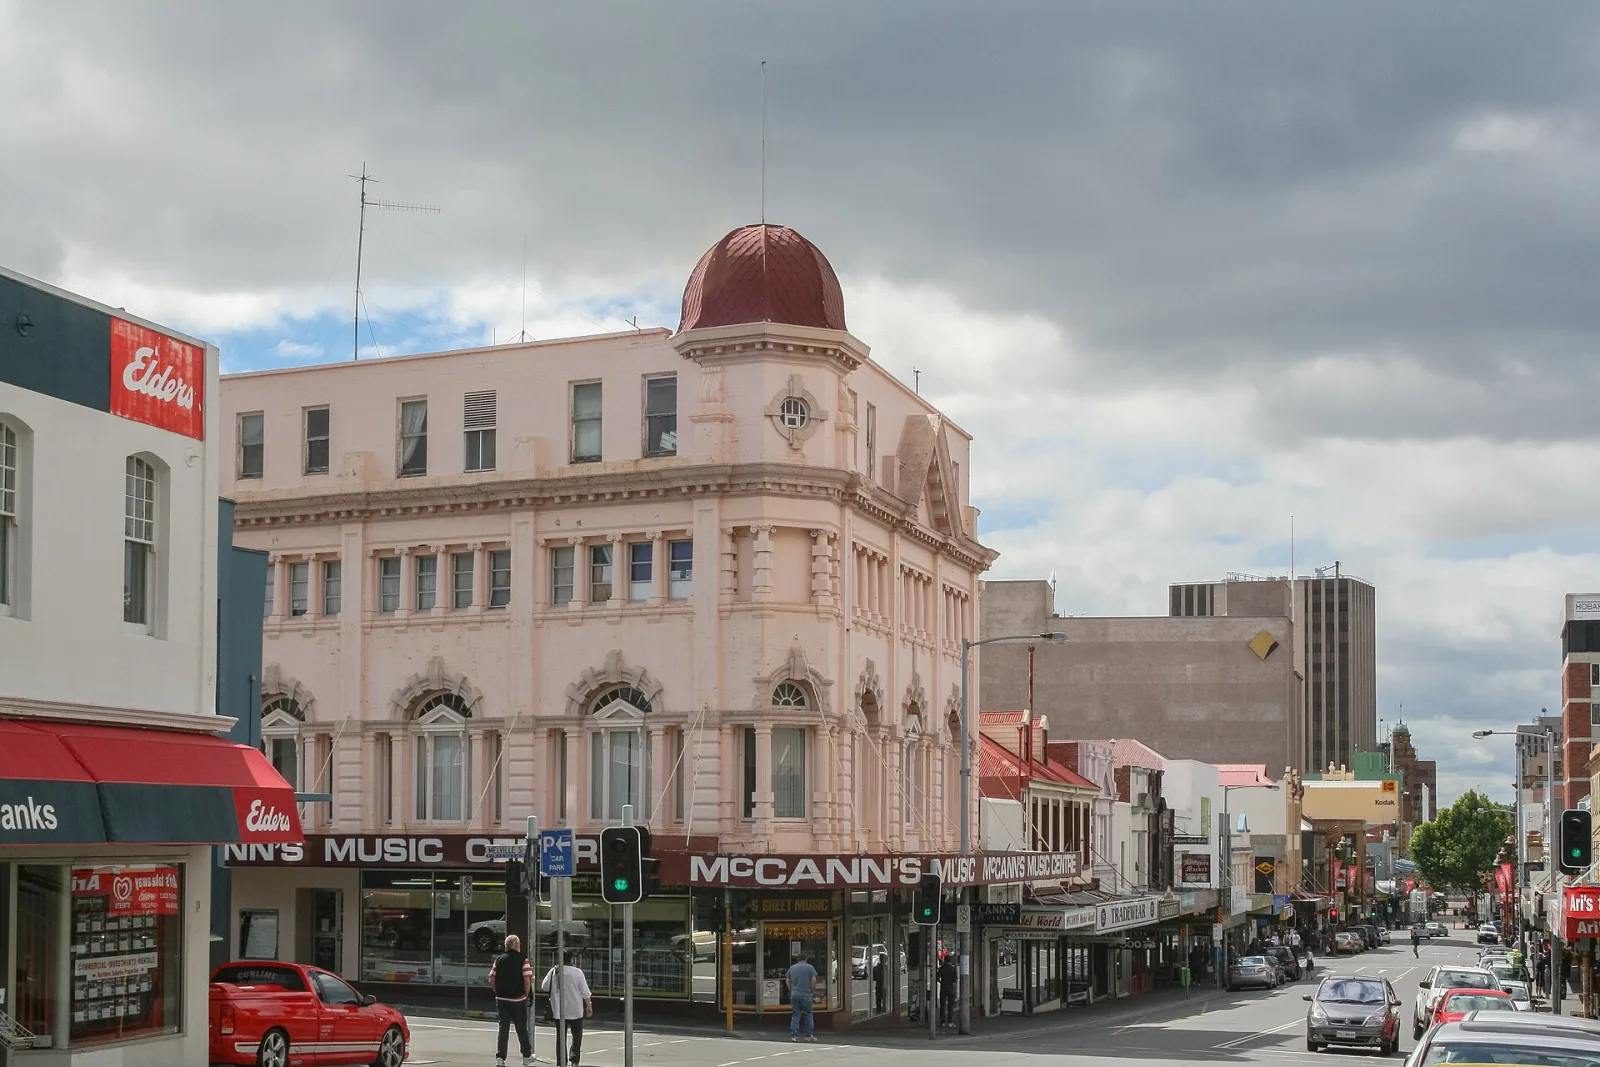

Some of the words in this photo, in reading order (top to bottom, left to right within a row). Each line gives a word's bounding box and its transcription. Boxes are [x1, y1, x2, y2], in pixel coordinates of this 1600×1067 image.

[122, 346, 194, 409] Elders
[1374, 799, 1395, 807] Kodak
[1, 797, 58, 830] anks
[246, 799, 291, 832] Elders
[324, 838, 444, 862] MUSIC
[488, 845, 515, 854] MELVILLE
[543, 836, 554, 853] P
[690, 856, 921, 885] McCANN'S
[983, 855, 1025, 880] McCANN'S
[1027, 854, 1051, 876] MUSIC
[1051, 853, 1077, 874] CENTRE
[762, 899, 792, 912] SHEET
[795, 898, 829, 912] MUSIC
[1570, 894, 1593, 912] Ari's
[1019, 914, 1033, 926] del
[1036, 916, 1063, 927] World
[1111, 903, 1146, 924] TRADEWEAR
[78, 959, 107, 972] COMMERCIAL
